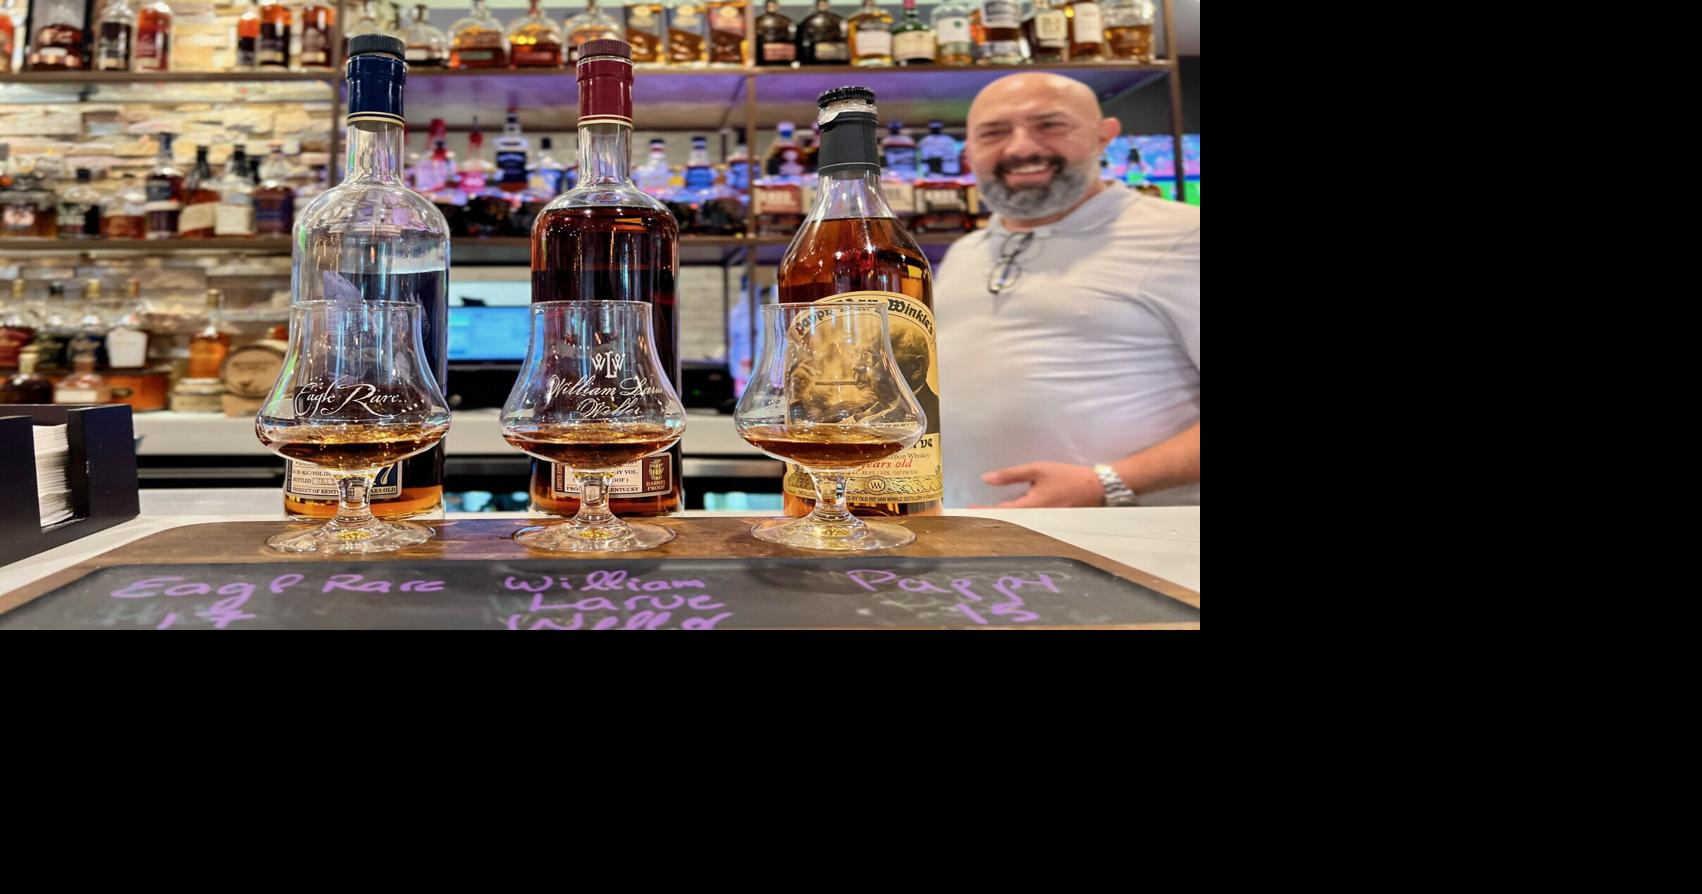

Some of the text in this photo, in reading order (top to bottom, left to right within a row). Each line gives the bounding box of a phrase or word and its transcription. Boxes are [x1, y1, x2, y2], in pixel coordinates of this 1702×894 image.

[888, 298, 935, 336] Winkle's
[294, 378, 400, 418] Eagle Rare
[546, 374, 617, 399] William
[858, 458, 913, 471] years old
[503, 570, 706, 593] William
[530, 592, 725, 612] Larue
